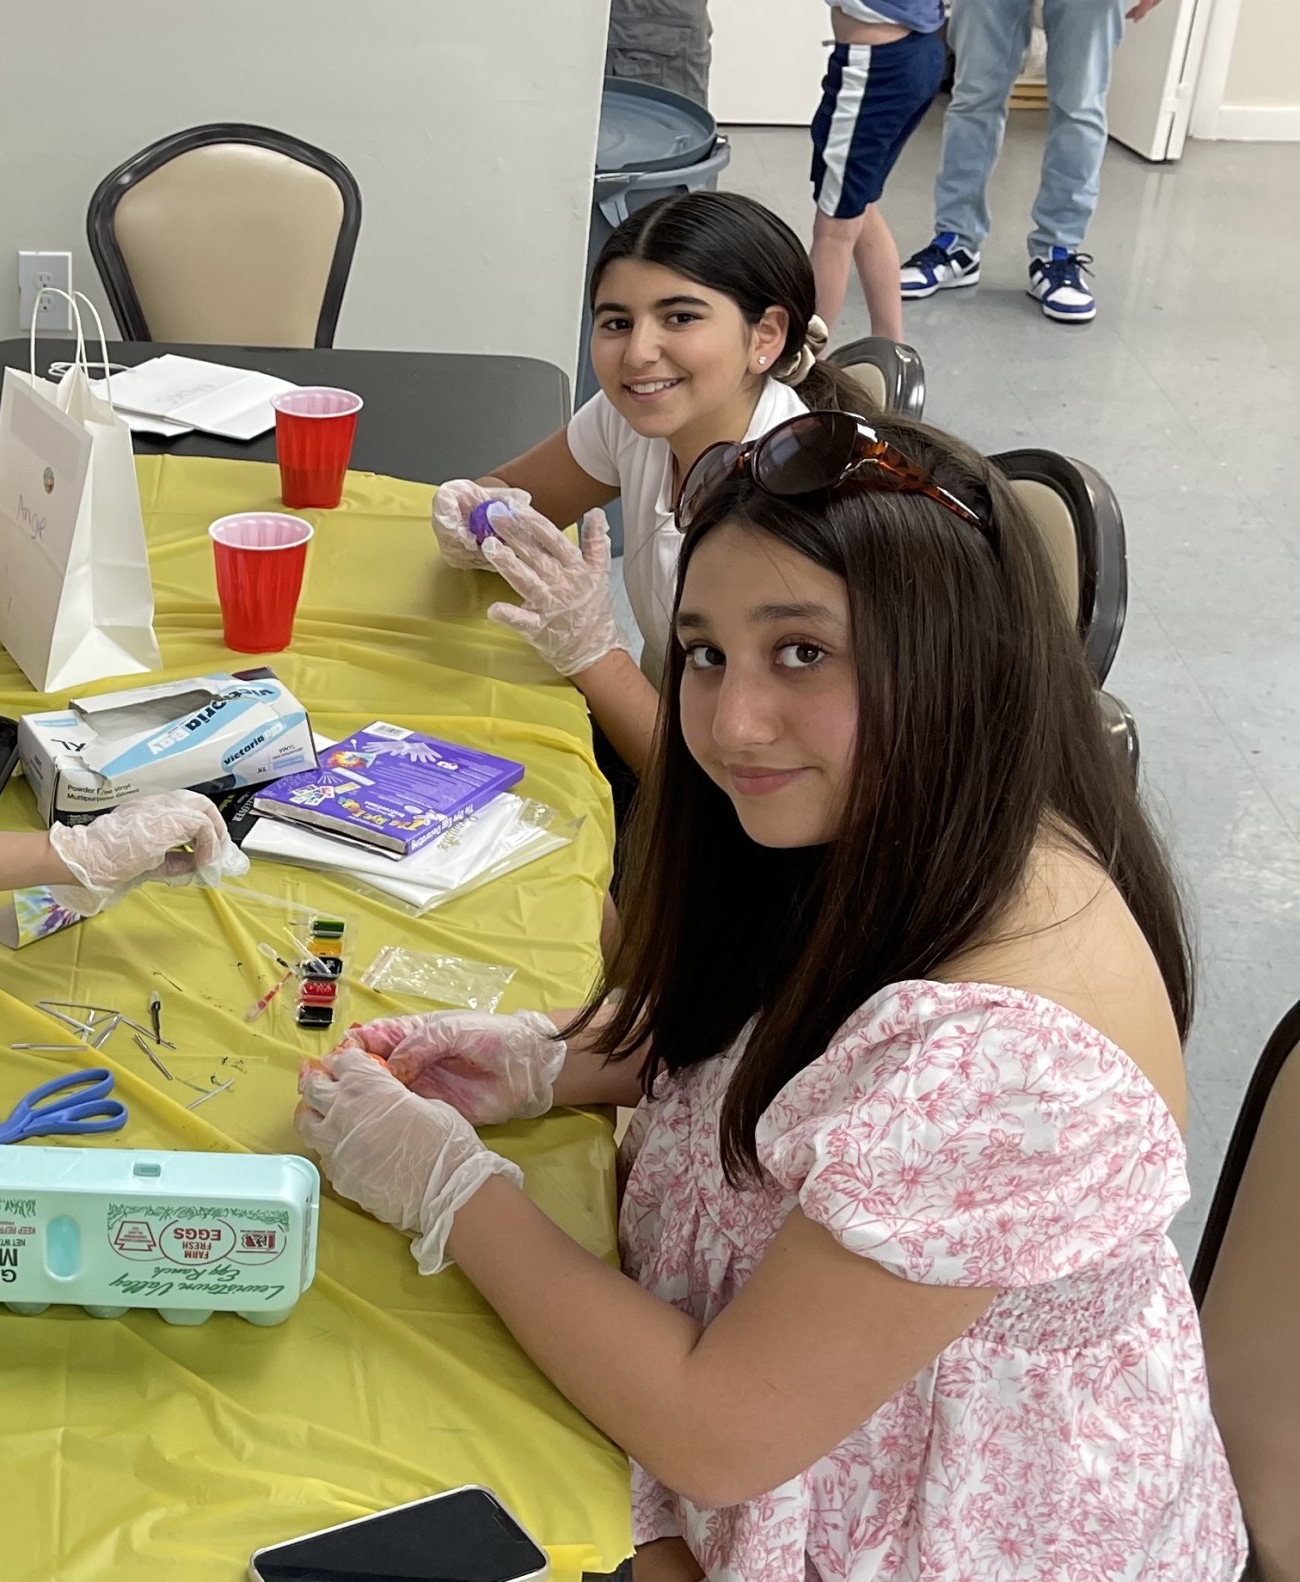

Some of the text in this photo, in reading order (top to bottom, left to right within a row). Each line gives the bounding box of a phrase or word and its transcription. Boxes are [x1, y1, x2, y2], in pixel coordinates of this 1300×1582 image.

[223, 734, 265, 764] Victoria
[67, 785, 95, 793] Powder
[66, 793, 113, 802] Multipurpose
[410, 824, 439, 849] Decorating
[17, 1226, 35, 1234] KEEP
[173, 1227, 221, 1241] EGGS
[12, 1238, 25, 1246] NET
[181, 1241, 211, 1250] FRESH
[183, 1249, 209, 1259] FARM
[153, 1263, 240, 1281] Egg Ranch
[109, 1273, 284, 1299] Lewistown Valley
